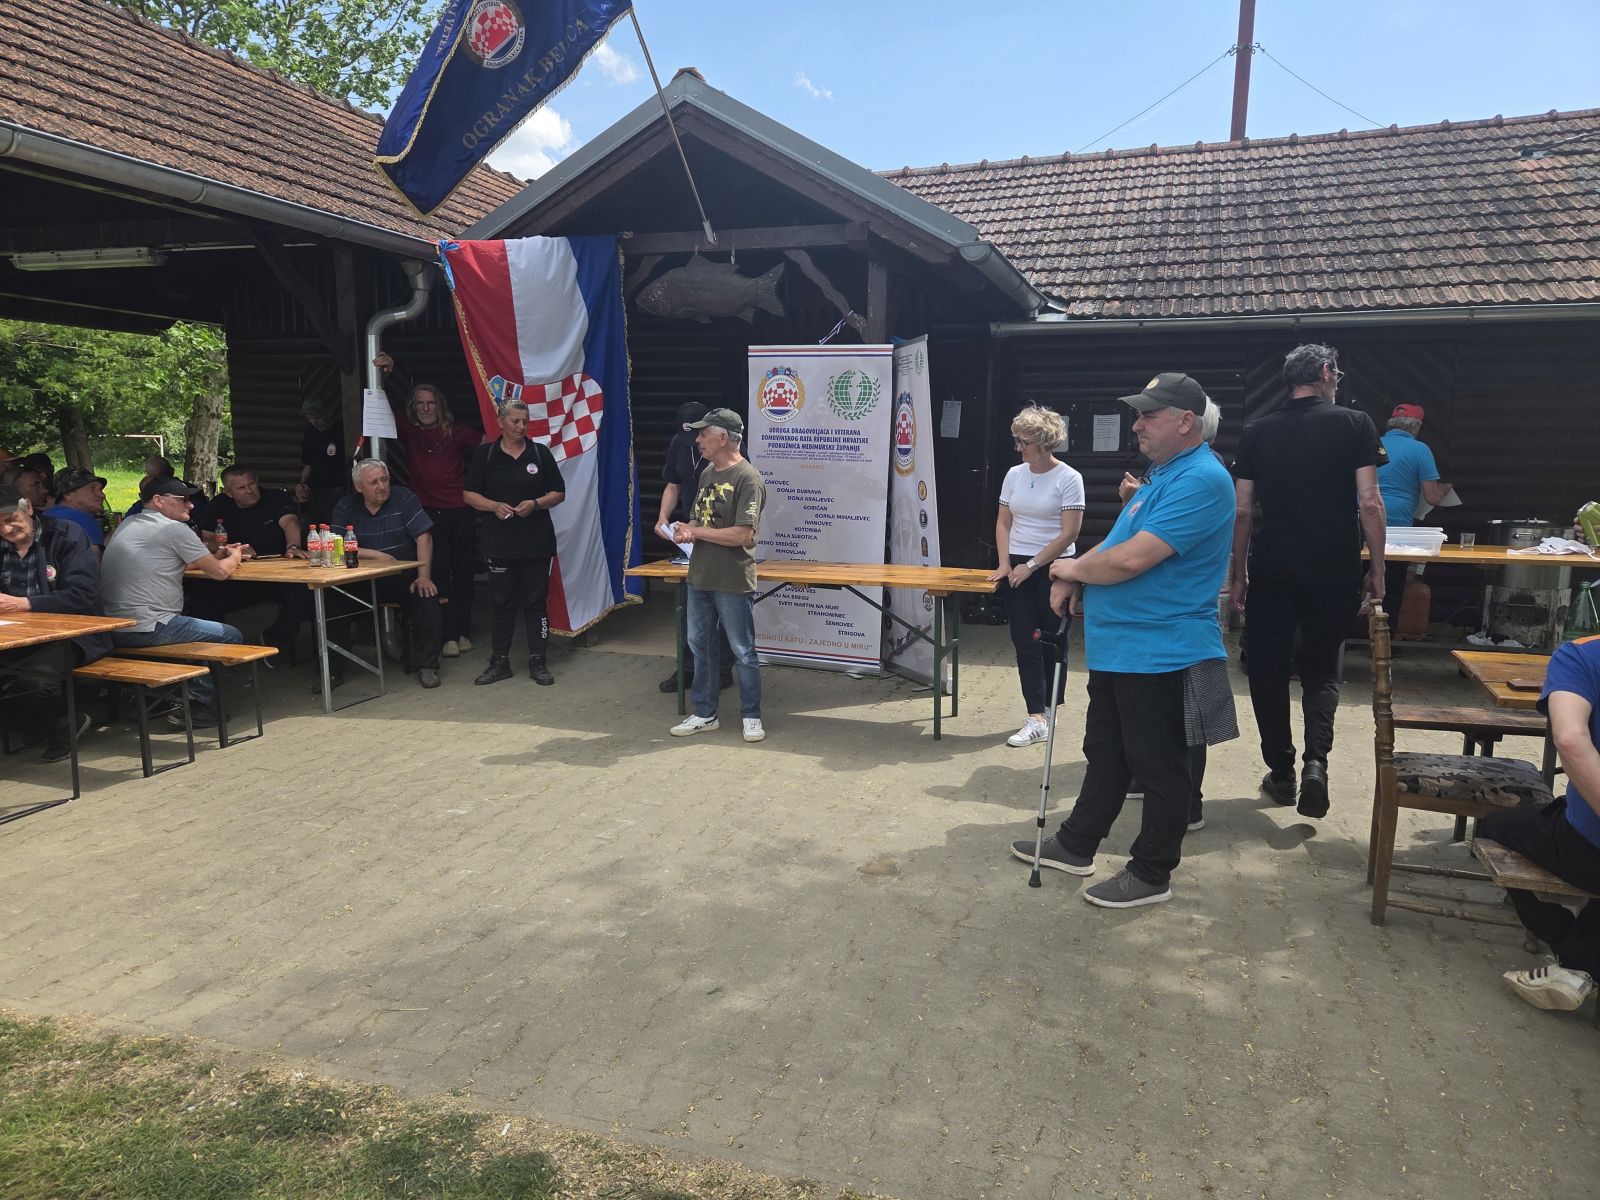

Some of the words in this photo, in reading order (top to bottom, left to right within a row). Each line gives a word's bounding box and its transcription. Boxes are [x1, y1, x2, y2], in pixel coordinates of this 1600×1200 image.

[462, 71, 542, 149] OGRANAK
[791, 428, 830, 436] DRAGOVOLJACA
[761, 434, 799, 442] DOMOVINSKOG
[768, 441, 801, 450] PODRUŽNICA
[807, 610, 846, 619] STRAHONINEC
[825, 619, 855, 628] ŠENKOVEC
[838, 629, 866, 638] ŠTRIGOVA
[784, 635, 803, 644] RATU
[808, 638, 843, 648] ZAJEDNO
